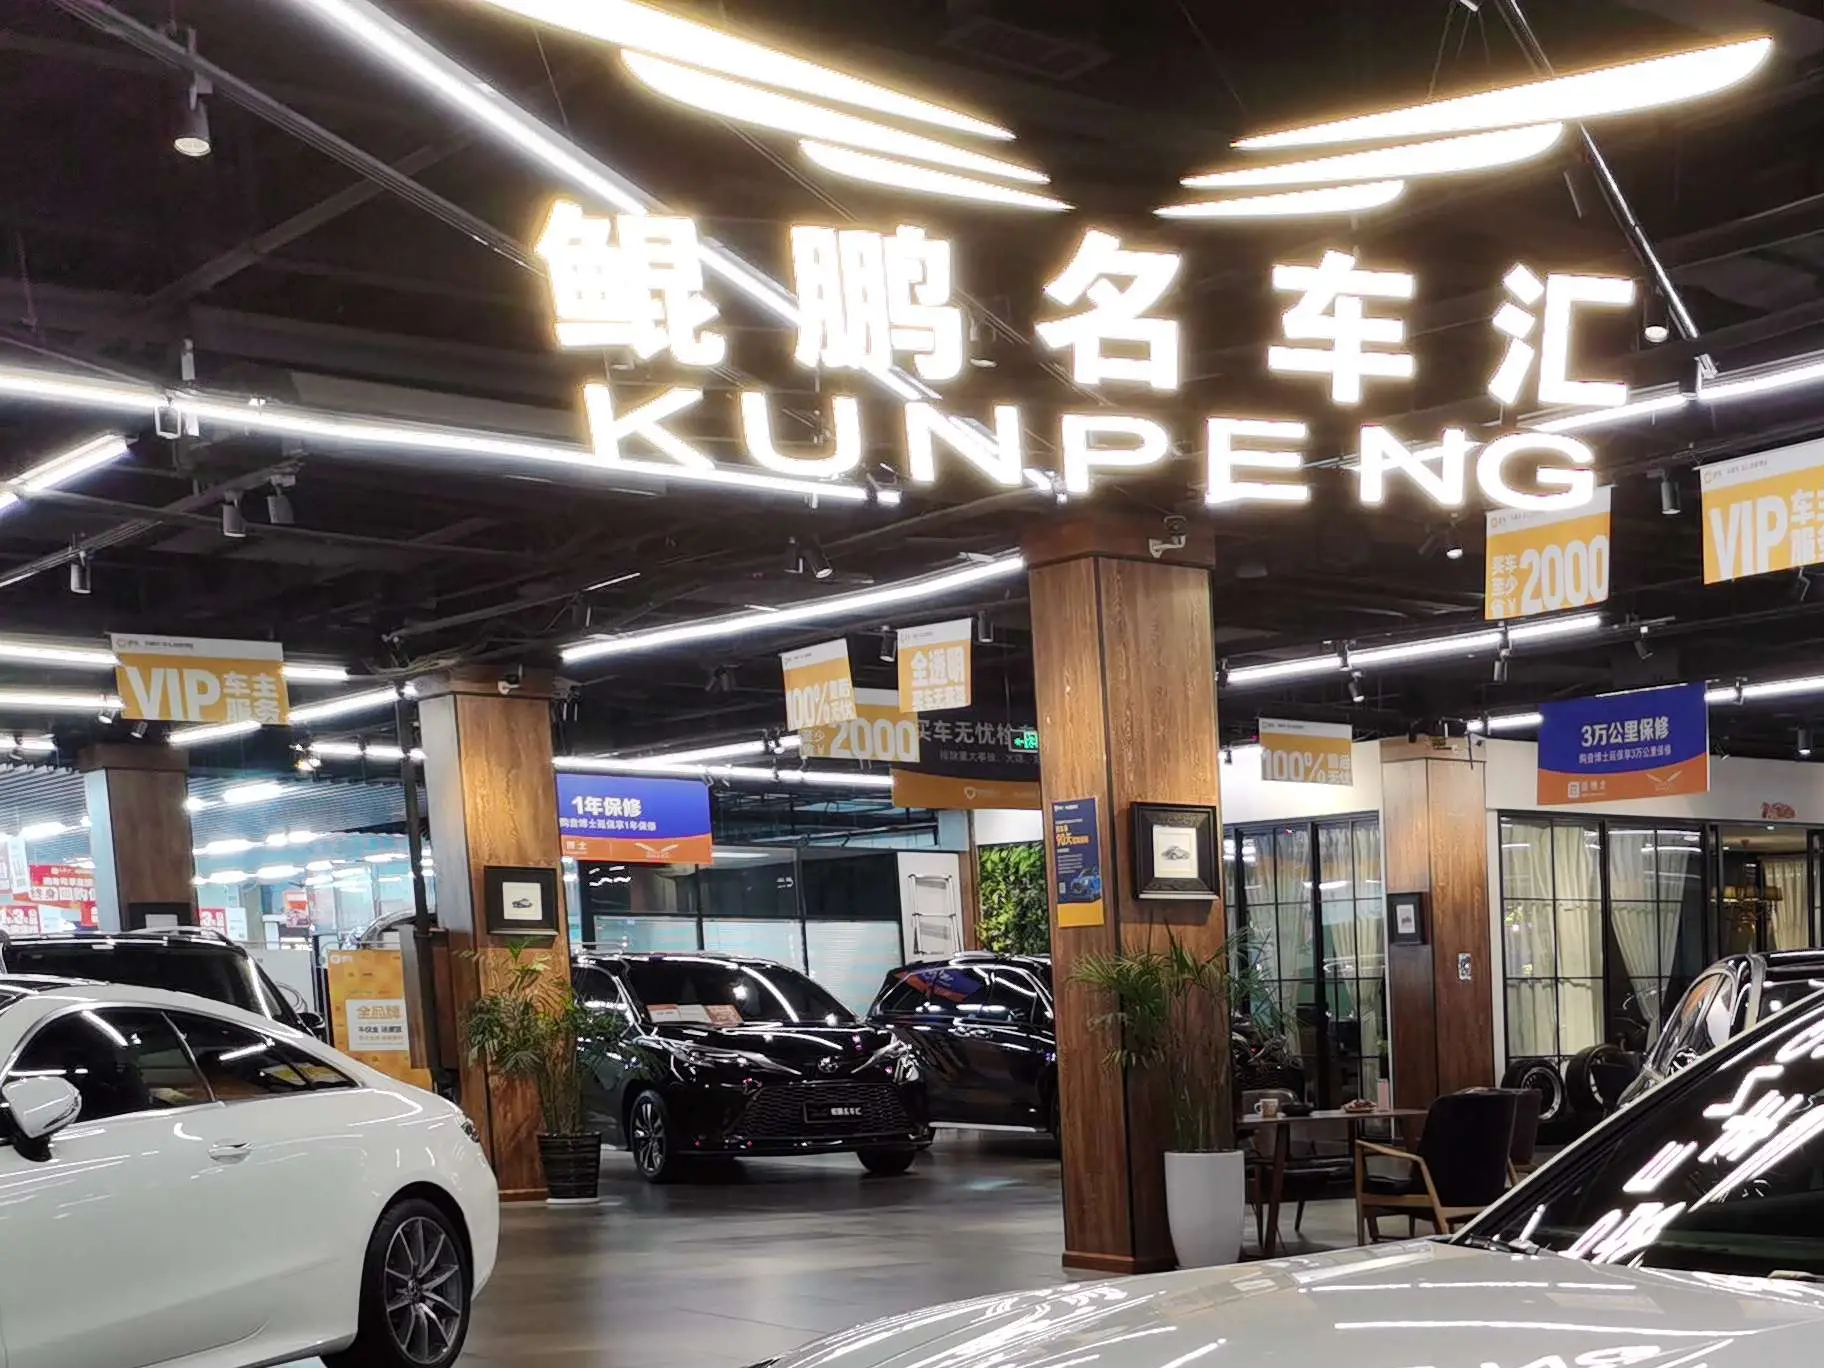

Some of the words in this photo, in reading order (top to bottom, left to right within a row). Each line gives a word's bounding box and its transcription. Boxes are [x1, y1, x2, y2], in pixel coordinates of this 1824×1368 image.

[535, 198, 1638, 406] 鲲鹏名车汇
[582, 383, 1600, 513] KUNPENG
[1708, 494, 1789, 581] VIP
[1519, 534, 1610, 617] 2000
[123, 666, 222, 722] VIP
[830, 718, 916, 763] 2000
[918, 719, 1036, 746] 买车无忧检
[1581, 715, 1670, 748] 3万公里保修
[572, 795, 642, 818] 1年保修
